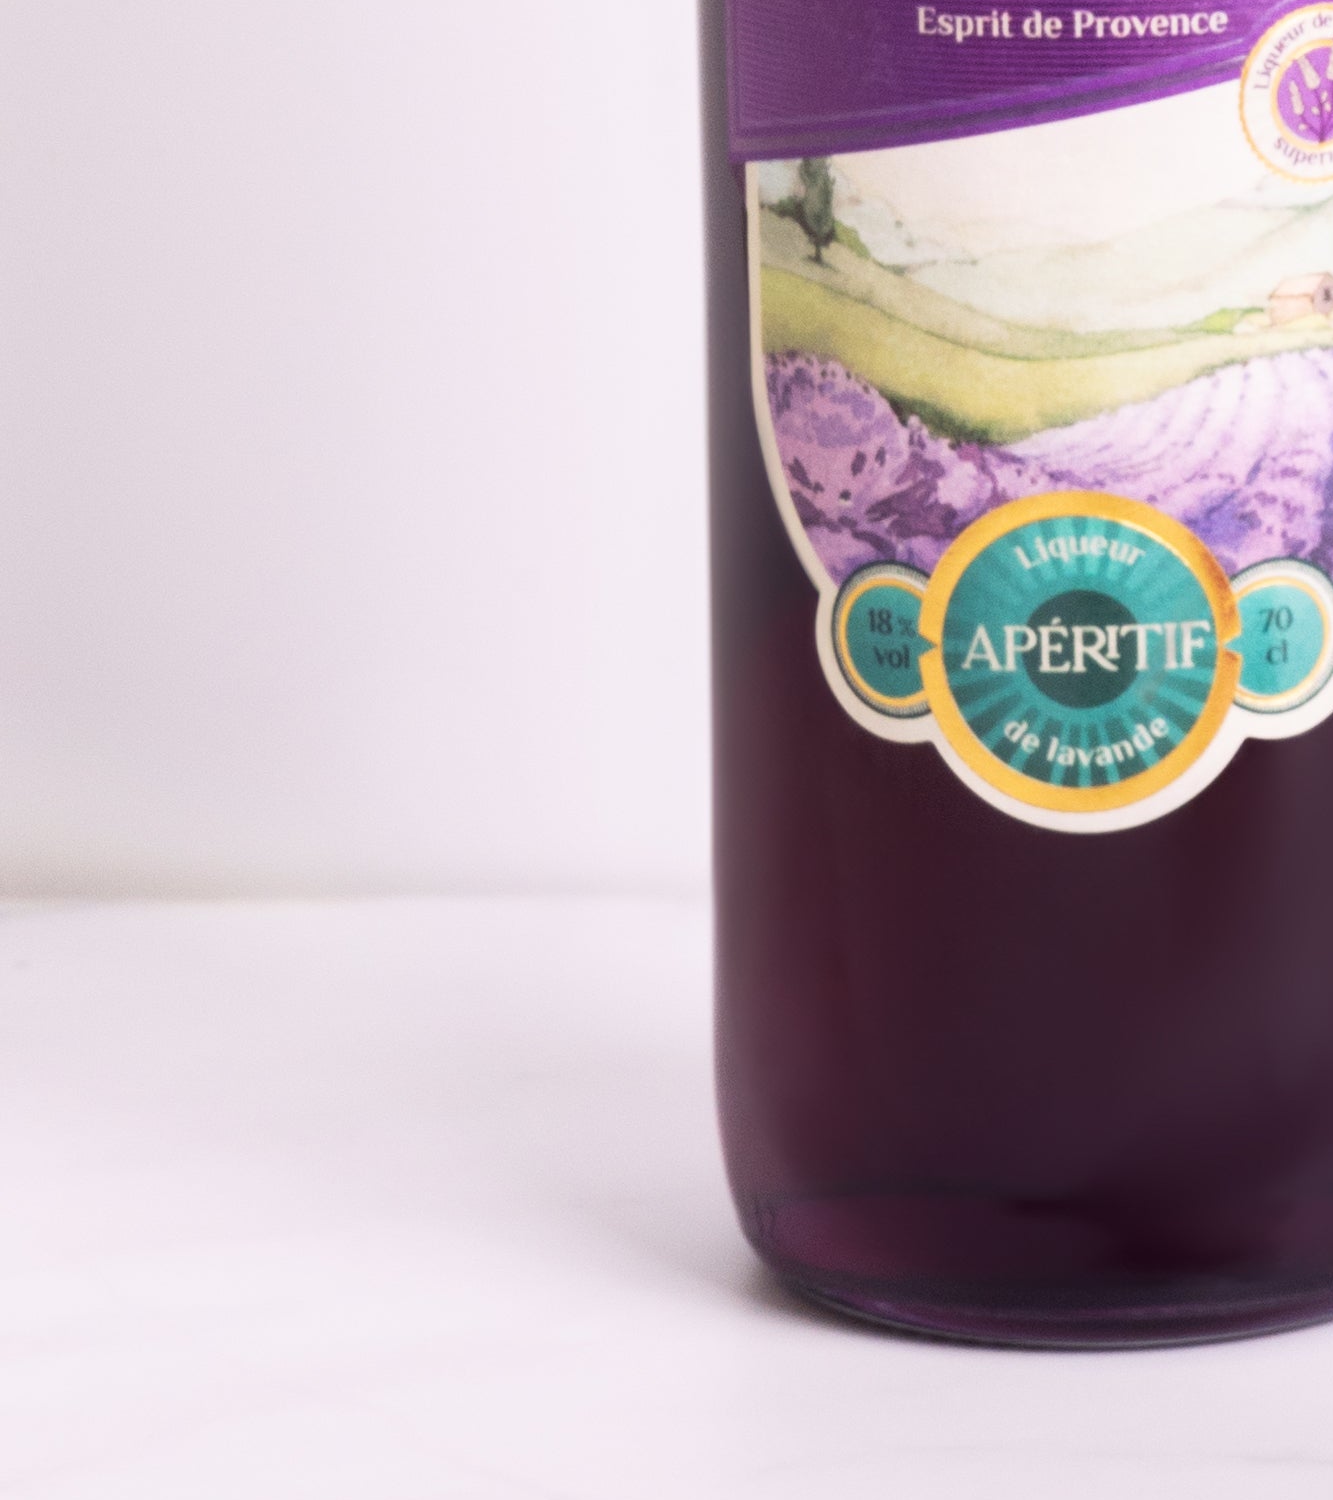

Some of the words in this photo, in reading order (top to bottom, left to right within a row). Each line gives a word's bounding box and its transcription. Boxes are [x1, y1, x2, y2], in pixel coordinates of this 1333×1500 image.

[916, 6, 1012, 43] Esprit
[1022, 10, 1063, 39] de
[1072, 10, 1229, 39] Provence
[1254, 20, 1305, 90] Liqueur
[1312, 12, 1333, 29] de
[1015, 534, 1146, 570] Liqueur
[868, 607, 893, 636] 18
[1259, 605, 1294, 633] 70
[961, 617, 1211, 674] APÉRITIF
[1266, 639, 1288, 665] cl
[1004, 720, 1040, 754] de
[1046, 717, 1169, 767] lavande
